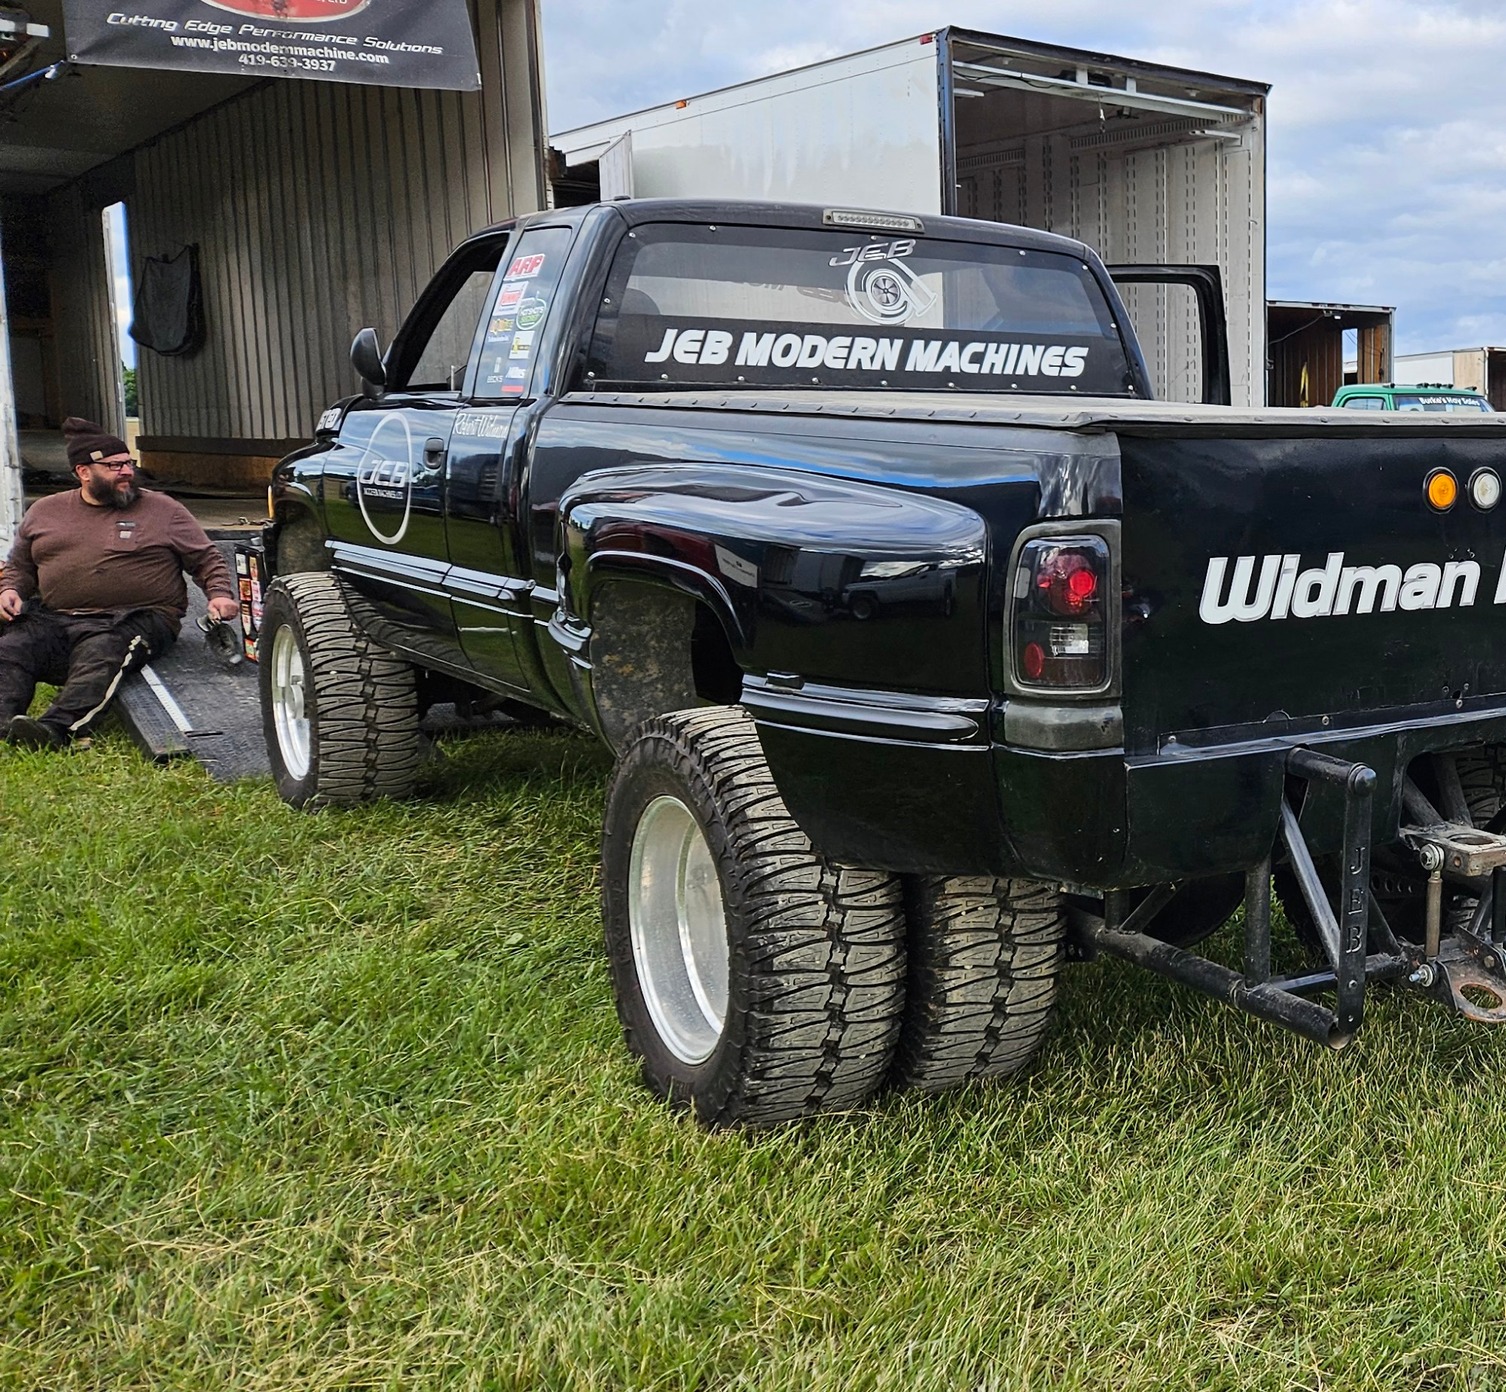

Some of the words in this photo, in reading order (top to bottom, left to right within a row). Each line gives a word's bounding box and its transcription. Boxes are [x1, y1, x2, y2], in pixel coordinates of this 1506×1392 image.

[106, 12, 178, 32] Cutting
[184, 20, 233, 35] Edge
[238, 24, 358, 46] Performance
[363, 36, 443, 55] Solutions
[238, 53, 336, 72] 419-639-3937
[828, 239, 916, 266] JEB
[645, 328, 734, 365] JEB
[734, 332, 903, 372] MODERN
[904, 340, 1089, 378] MACHINES
[360, 459, 409, 488] JEB
[1199, 551, 1481, 625] Widman
